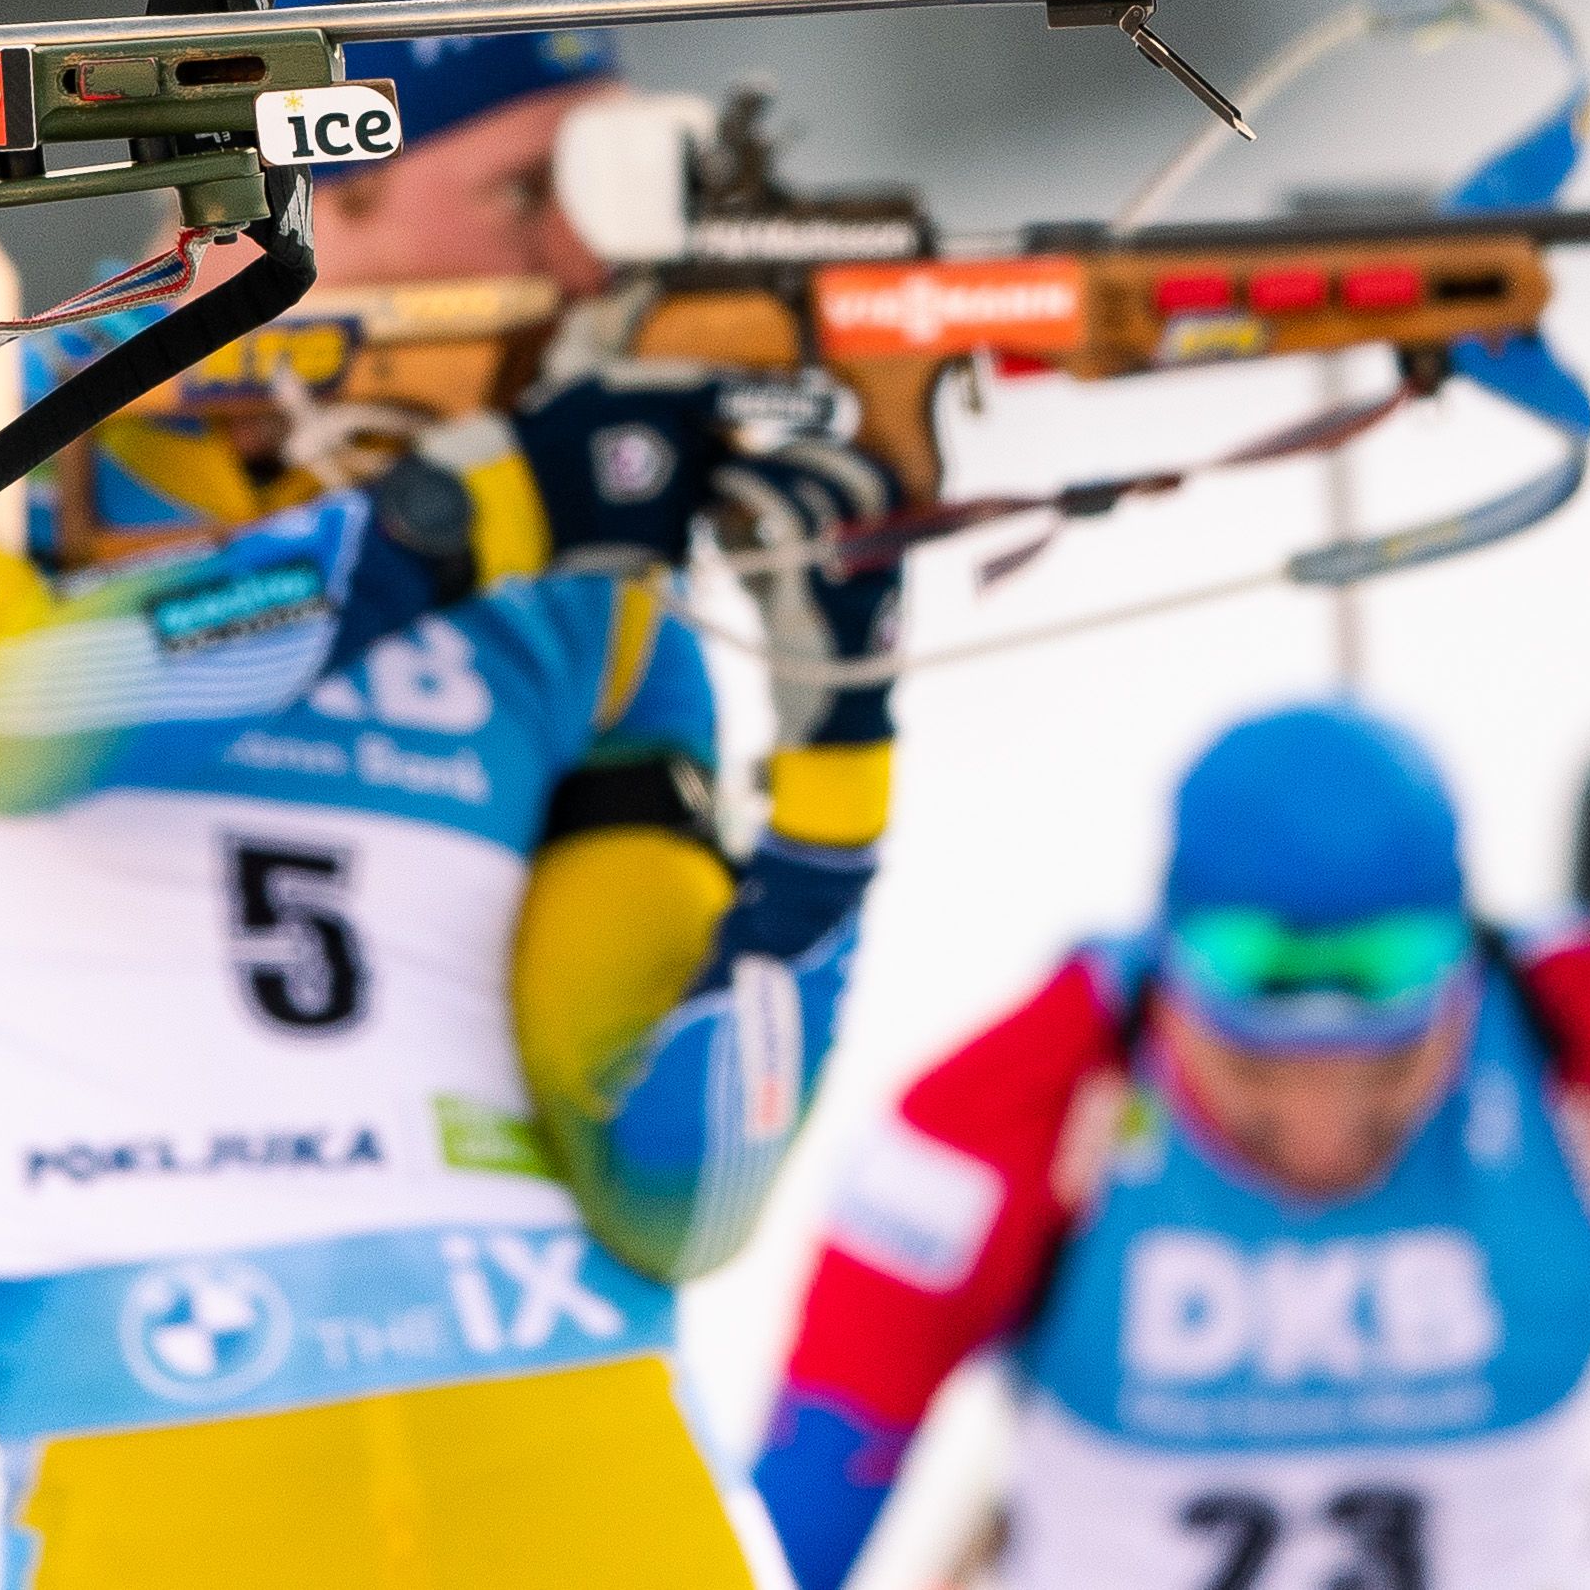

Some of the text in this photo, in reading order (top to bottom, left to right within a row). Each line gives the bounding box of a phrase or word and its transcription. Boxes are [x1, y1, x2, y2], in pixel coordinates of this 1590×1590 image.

[287, 108, 393, 159] ice
[226, 835, 366, 1040] 5
[1122, 1228, 1500, 1380] DKB
